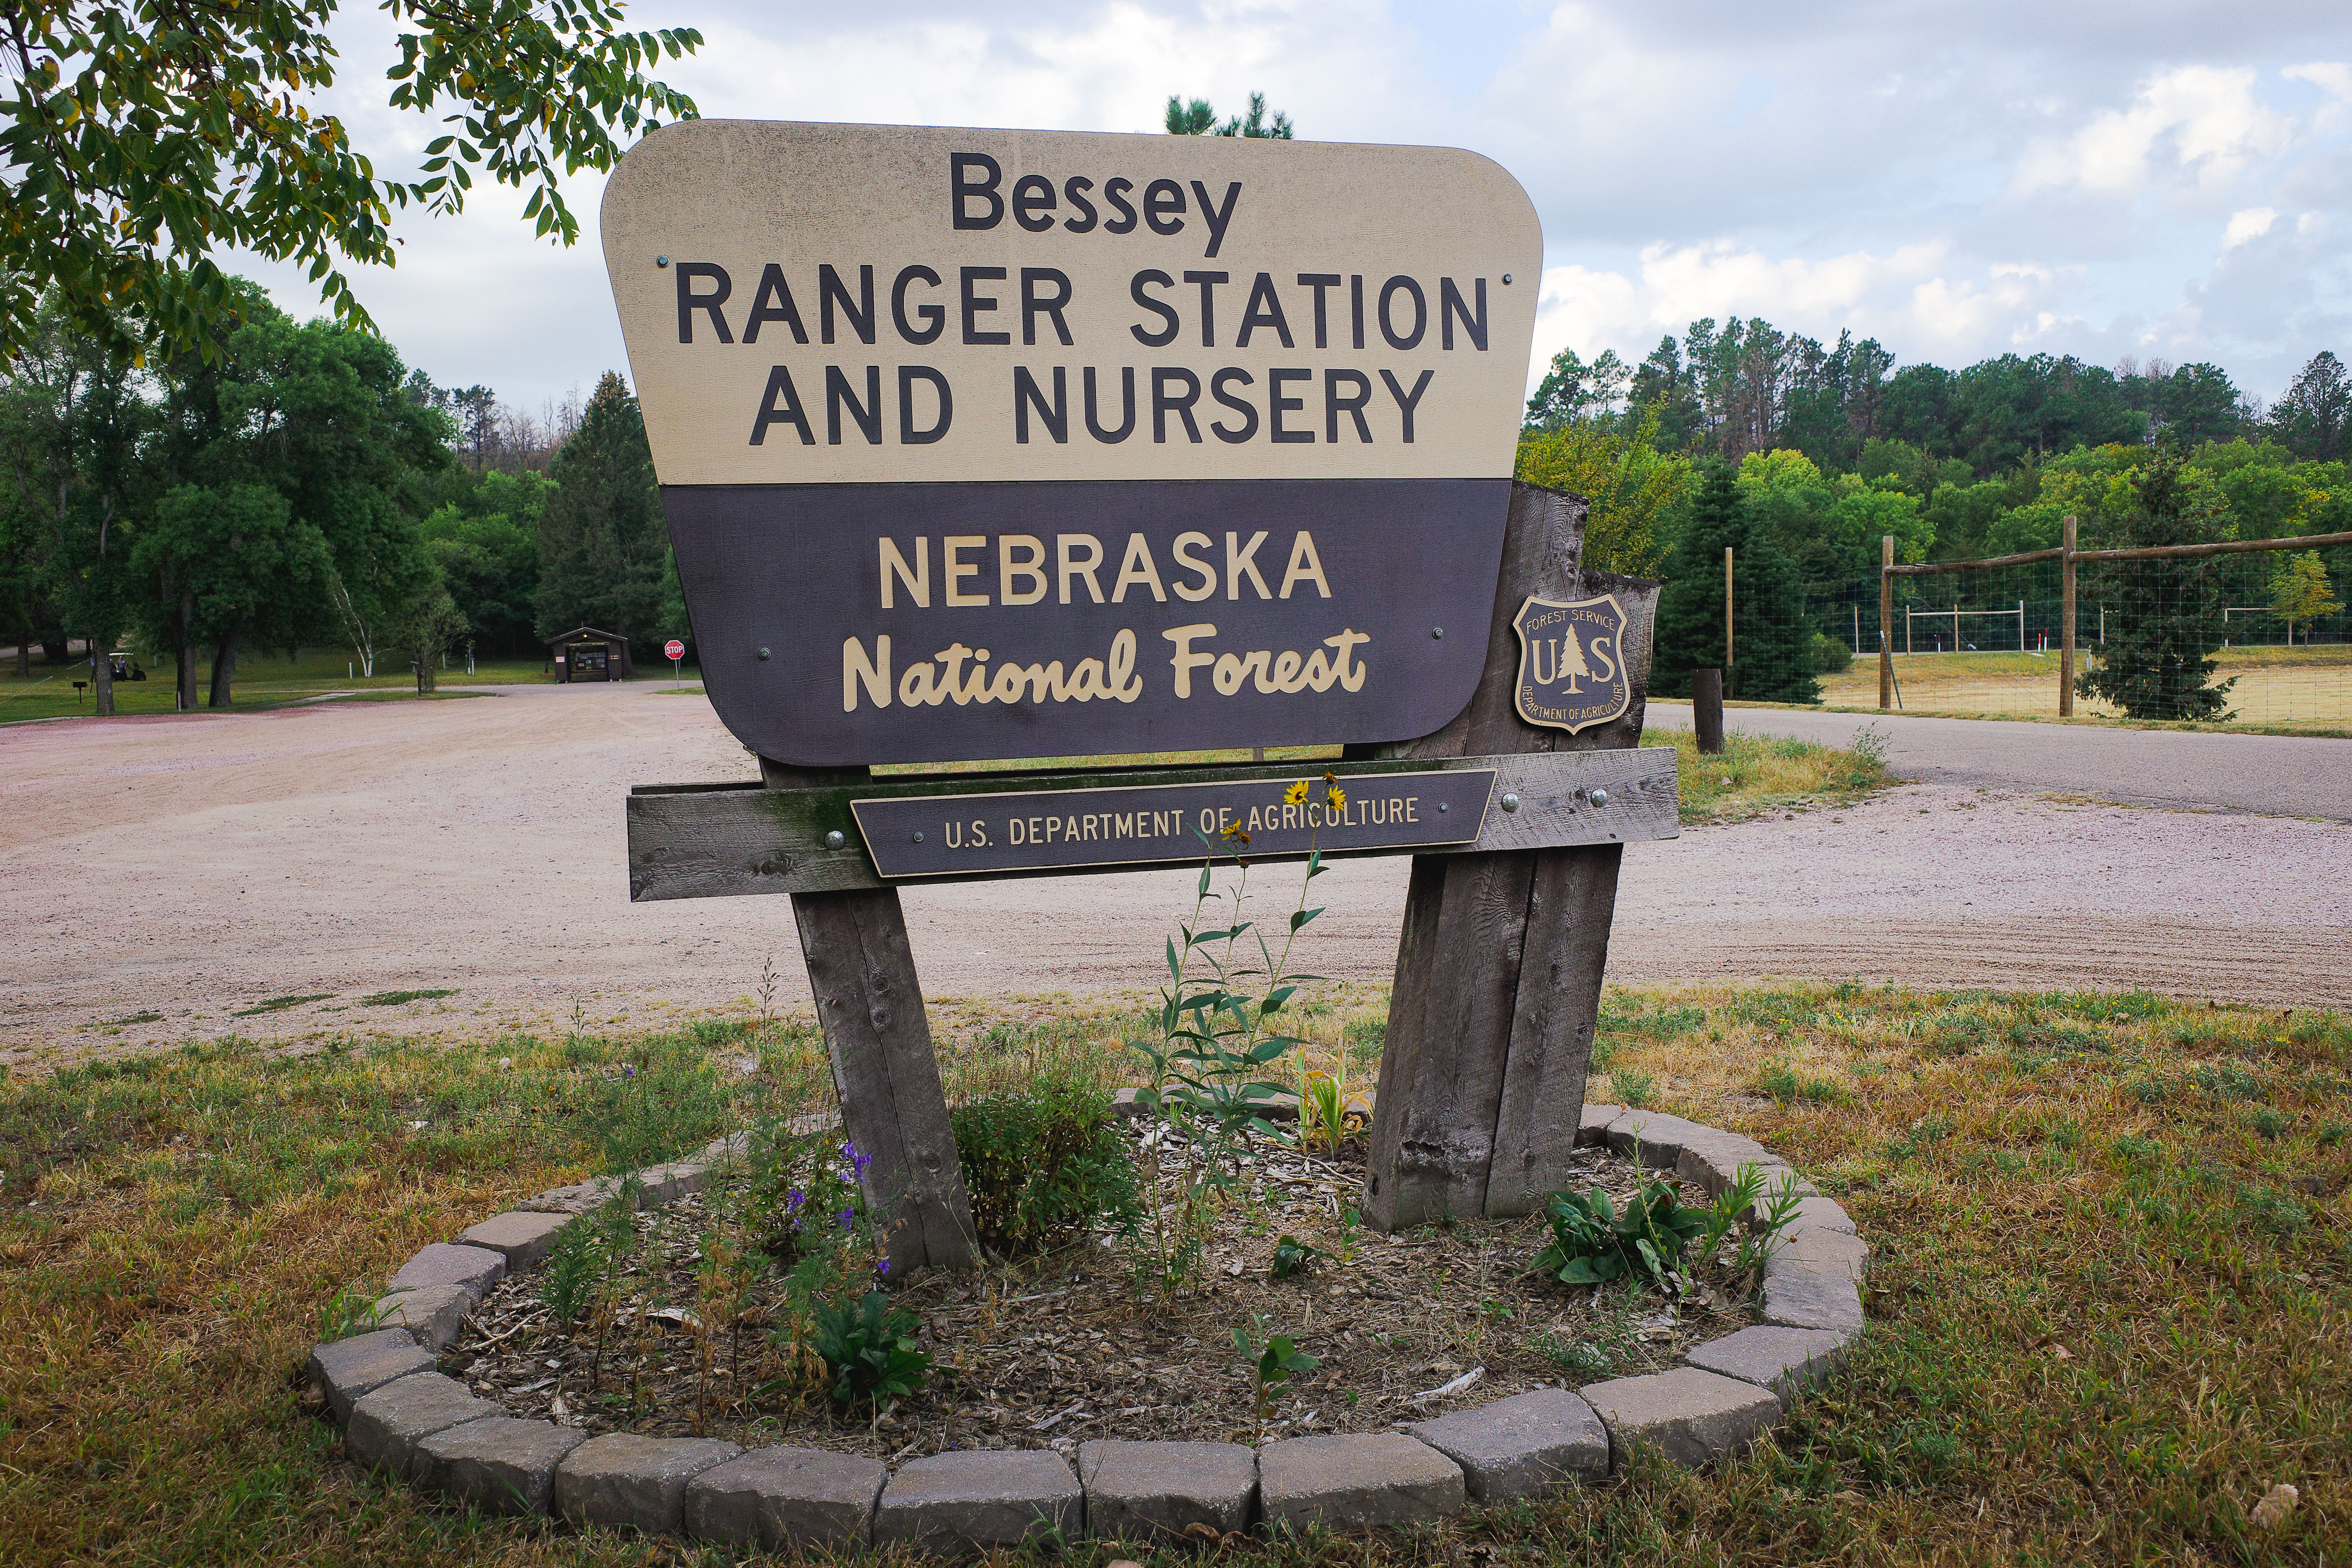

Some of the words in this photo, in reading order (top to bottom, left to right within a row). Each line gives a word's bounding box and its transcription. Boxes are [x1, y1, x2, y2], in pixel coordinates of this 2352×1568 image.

[950, 152, 1242, 258] Bessey
[676, 262, 1074, 346] RANGER
[1130, 269, 1488, 351] STATION
[749, 365, 953, 446] AND
[1014, 366, 1435, 445] NURSERY
[879, 531, 1332, 608] NEBRASKA
[666, 646, 682, 654] STOP
[1527, 610, 1568, 634] FOREST
[1571, 609, 1615, 631] SERVICE
[843, 628, 1143, 712] National
[1162, 623, 1370, 699] Forest
[1523, 686, 1567, 720] DEPARTMENT
[1569, 708, 1580, 719] OF
[1581, 682, 1624, 719] AGRICULTURE
[946, 820, 993, 848] U.S.
[1010, 810, 1184, 845] DEPARTMENT
[1200, 807, 1232, 834] OF
[1247, 797, 1419, 831] AGRICULTURE
